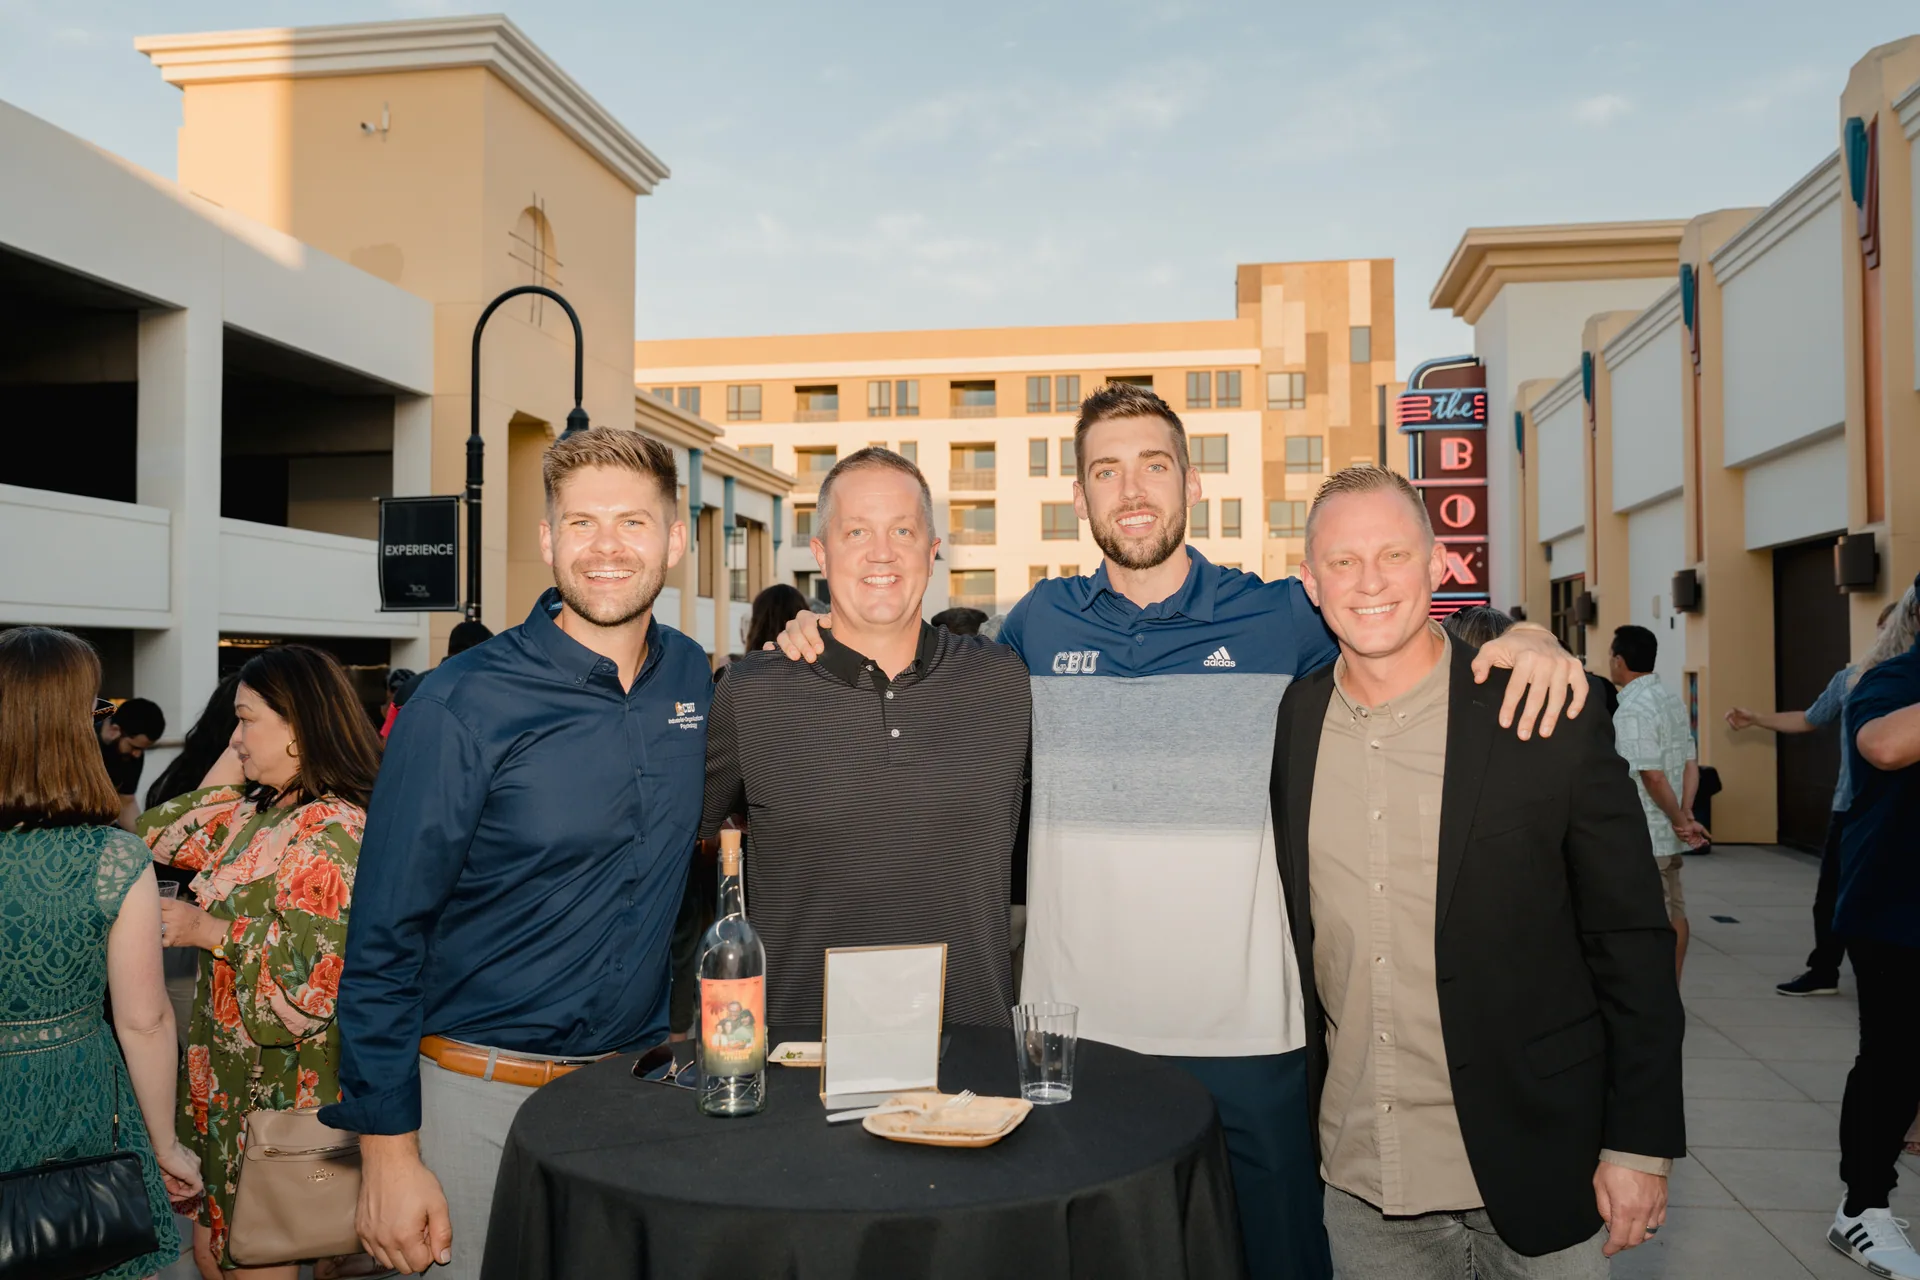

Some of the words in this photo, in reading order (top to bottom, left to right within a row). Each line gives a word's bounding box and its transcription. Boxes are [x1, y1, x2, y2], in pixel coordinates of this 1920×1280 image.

[1431, 390, 1474, 419] the
[1440, 437, 1477, 585] BOX
[385, 543, 454, 556] EXPERIENCE
[1052, 650, 1100, 674] CBU
[1203, 659, 1236, 668] adidas
